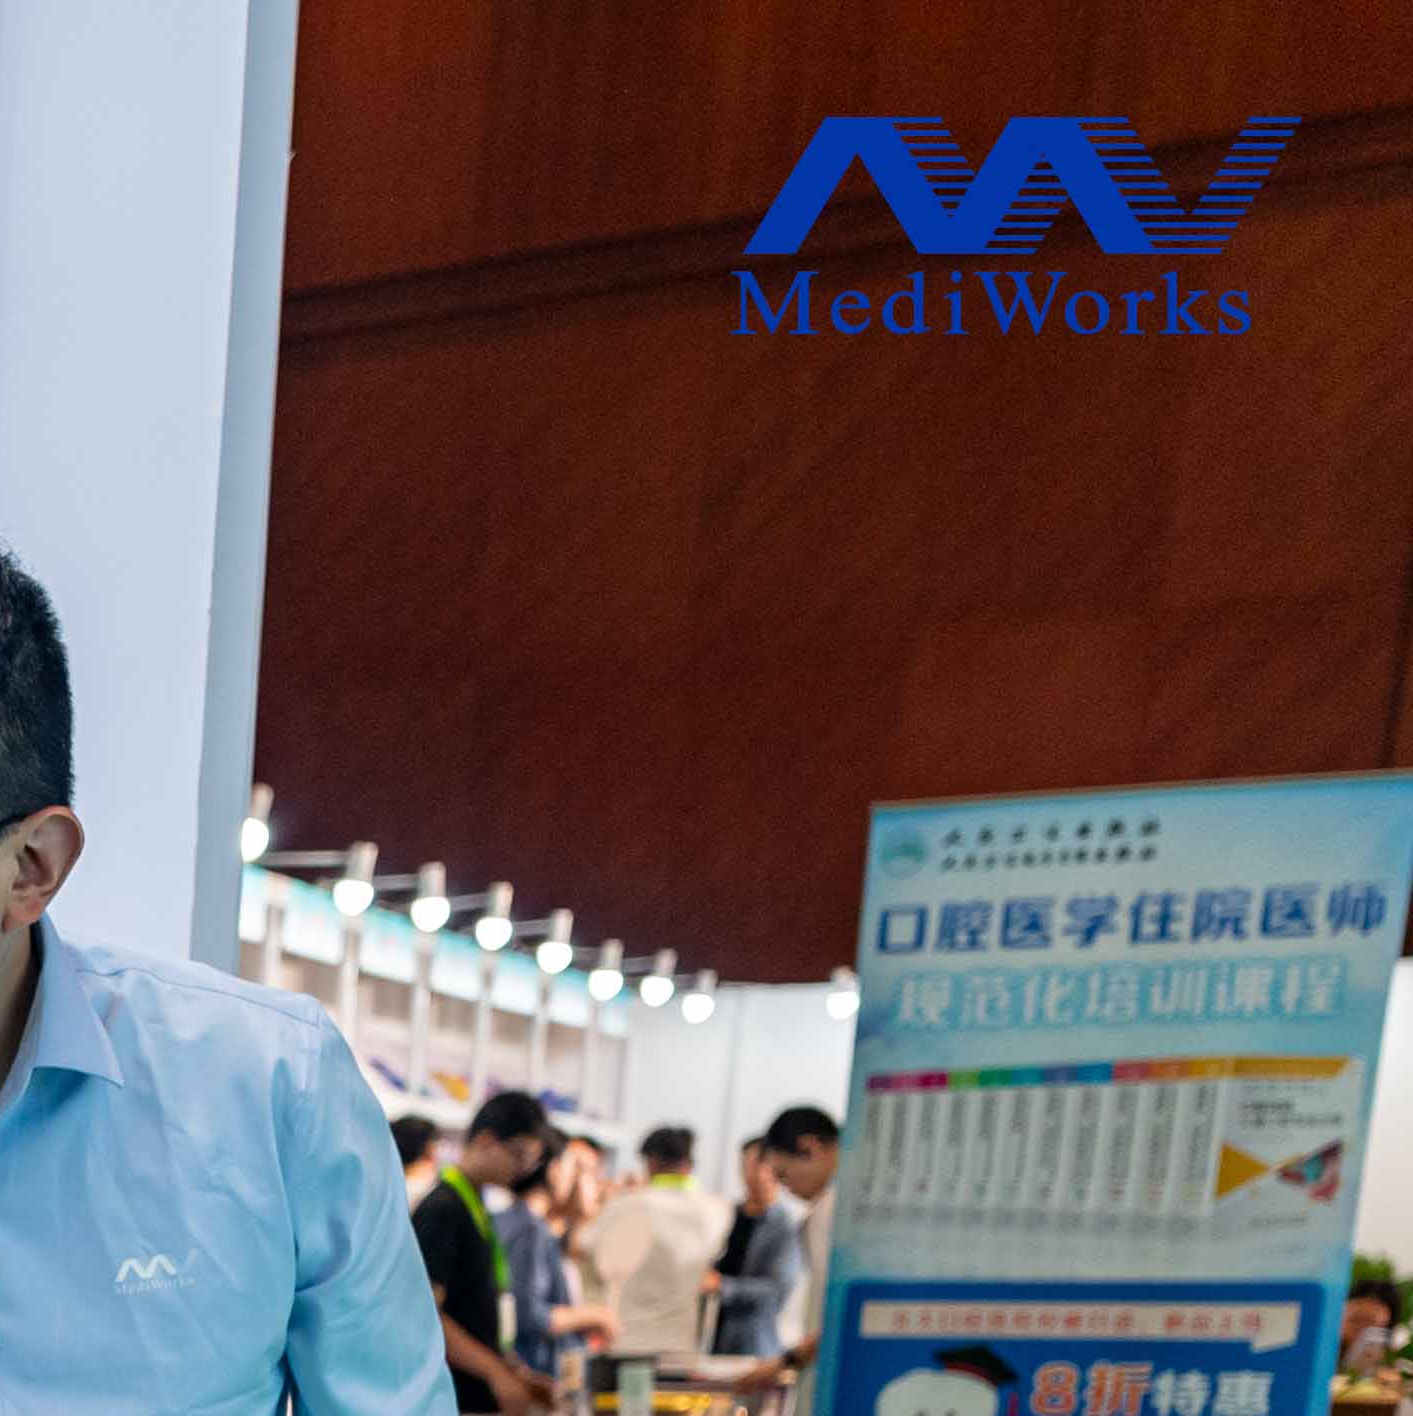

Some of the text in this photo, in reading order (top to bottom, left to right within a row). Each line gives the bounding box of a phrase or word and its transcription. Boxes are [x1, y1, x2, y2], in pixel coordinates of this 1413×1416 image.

[876, 882, 1388, 954] 口腔医学住院医师
